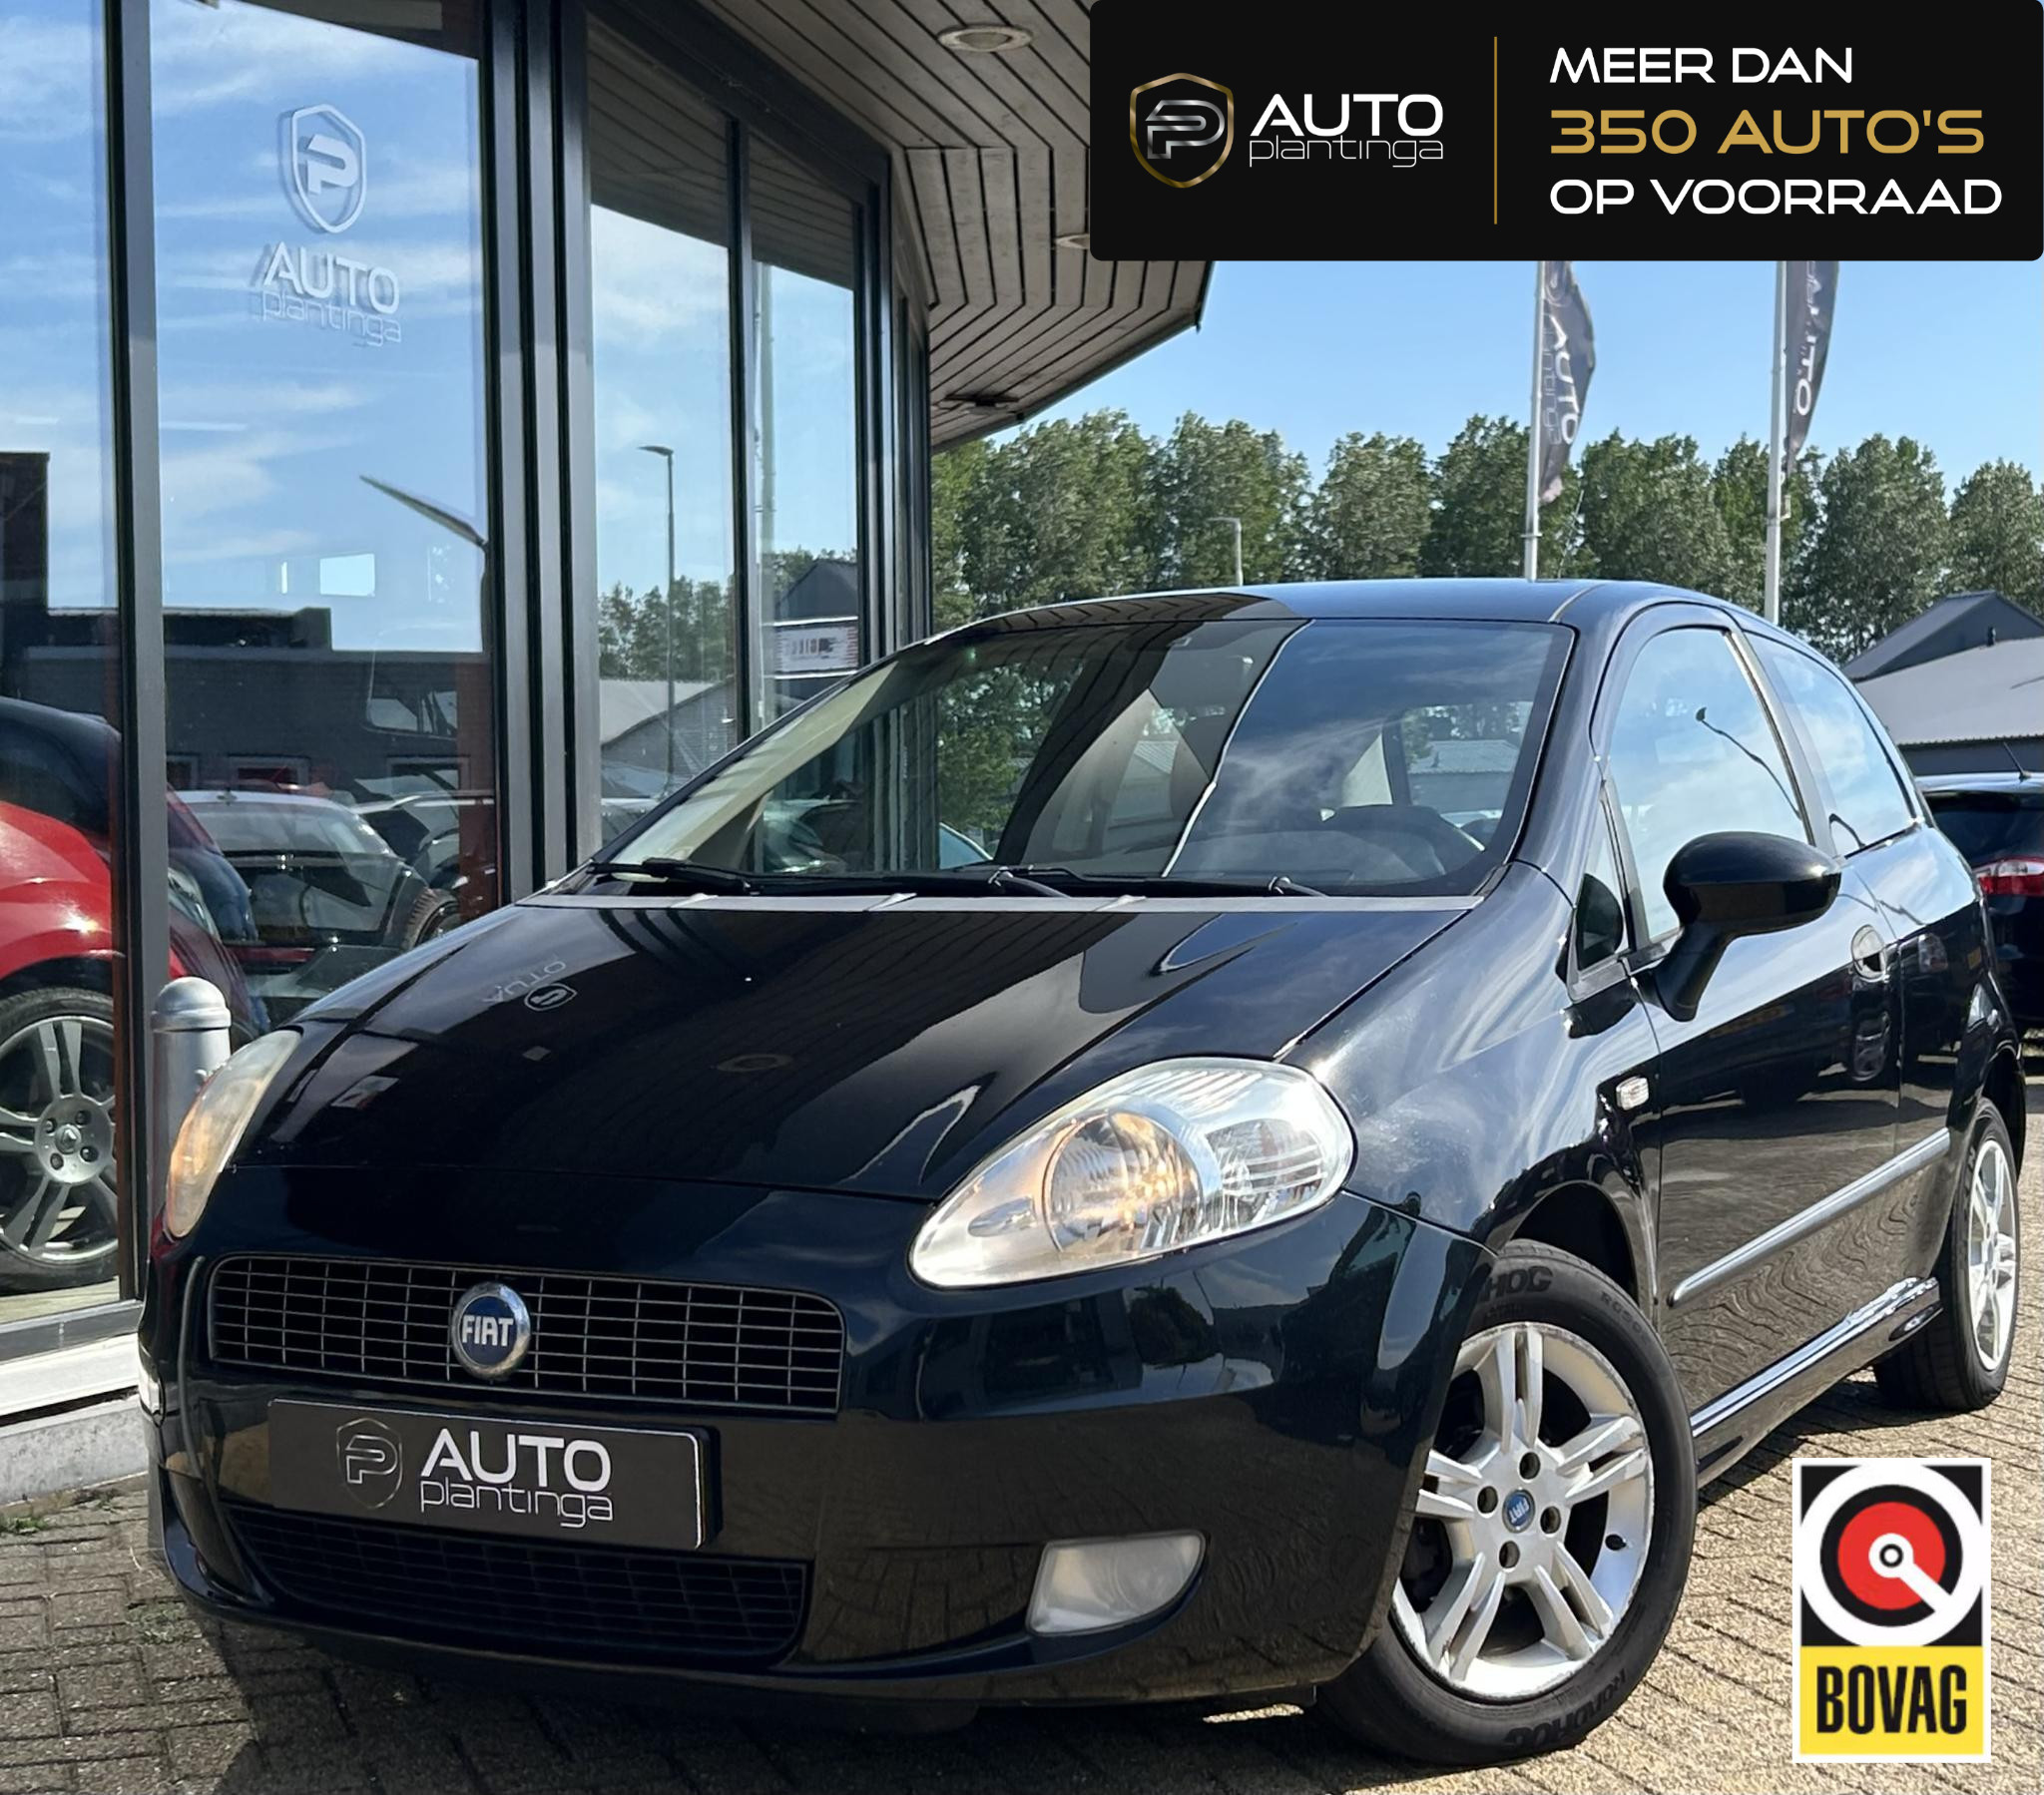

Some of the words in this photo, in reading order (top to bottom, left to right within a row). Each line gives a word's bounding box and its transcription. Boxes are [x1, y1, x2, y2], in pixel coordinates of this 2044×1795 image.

[262, 241, 400, 314] AUTO
[262, 289, 402, 347] plantinga
[1550, 315, 1580, 445] AUTO
[461, 1314, 514, 1347] FIAT
[421, 1428, 613, 1492] AUTO
[420, 1480, 614, 1529] plantinga
